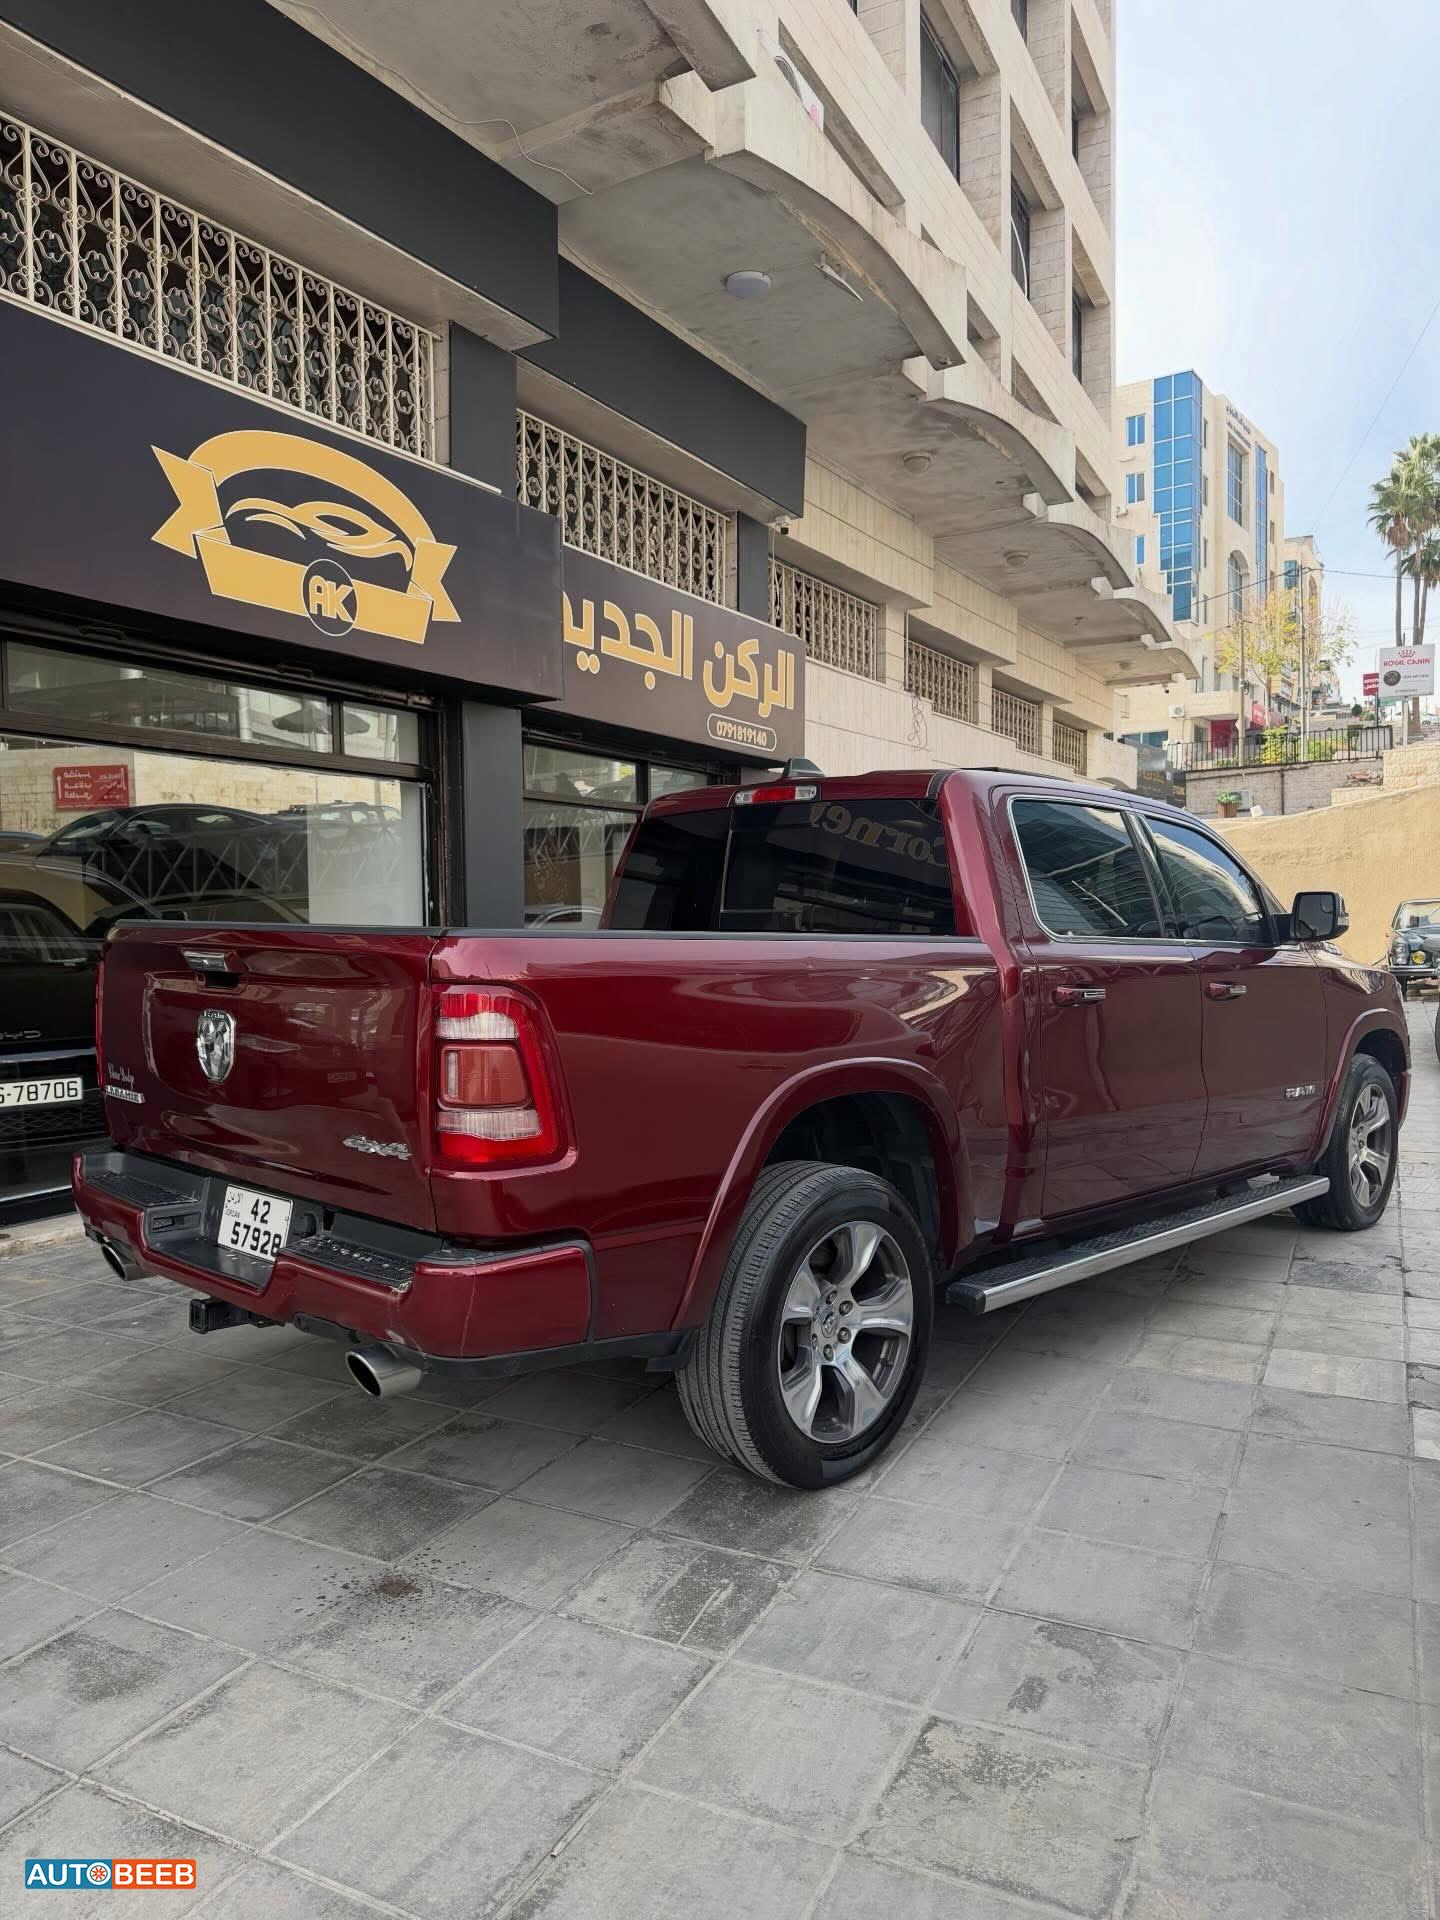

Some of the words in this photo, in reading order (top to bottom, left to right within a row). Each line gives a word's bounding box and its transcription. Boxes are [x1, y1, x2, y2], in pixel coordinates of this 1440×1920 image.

[309, 575, 353, 622] AK
[702, 638, 796, 718] الركن
[715, 721, 768, 747] 0791819140
[106, 1086, 142, 1102] LARAMIE
[1286, 1085, 1316, 1098] RAM
[250, 1198, 271, 1225] 42
[231, 1221, 282, 1257] 57928
